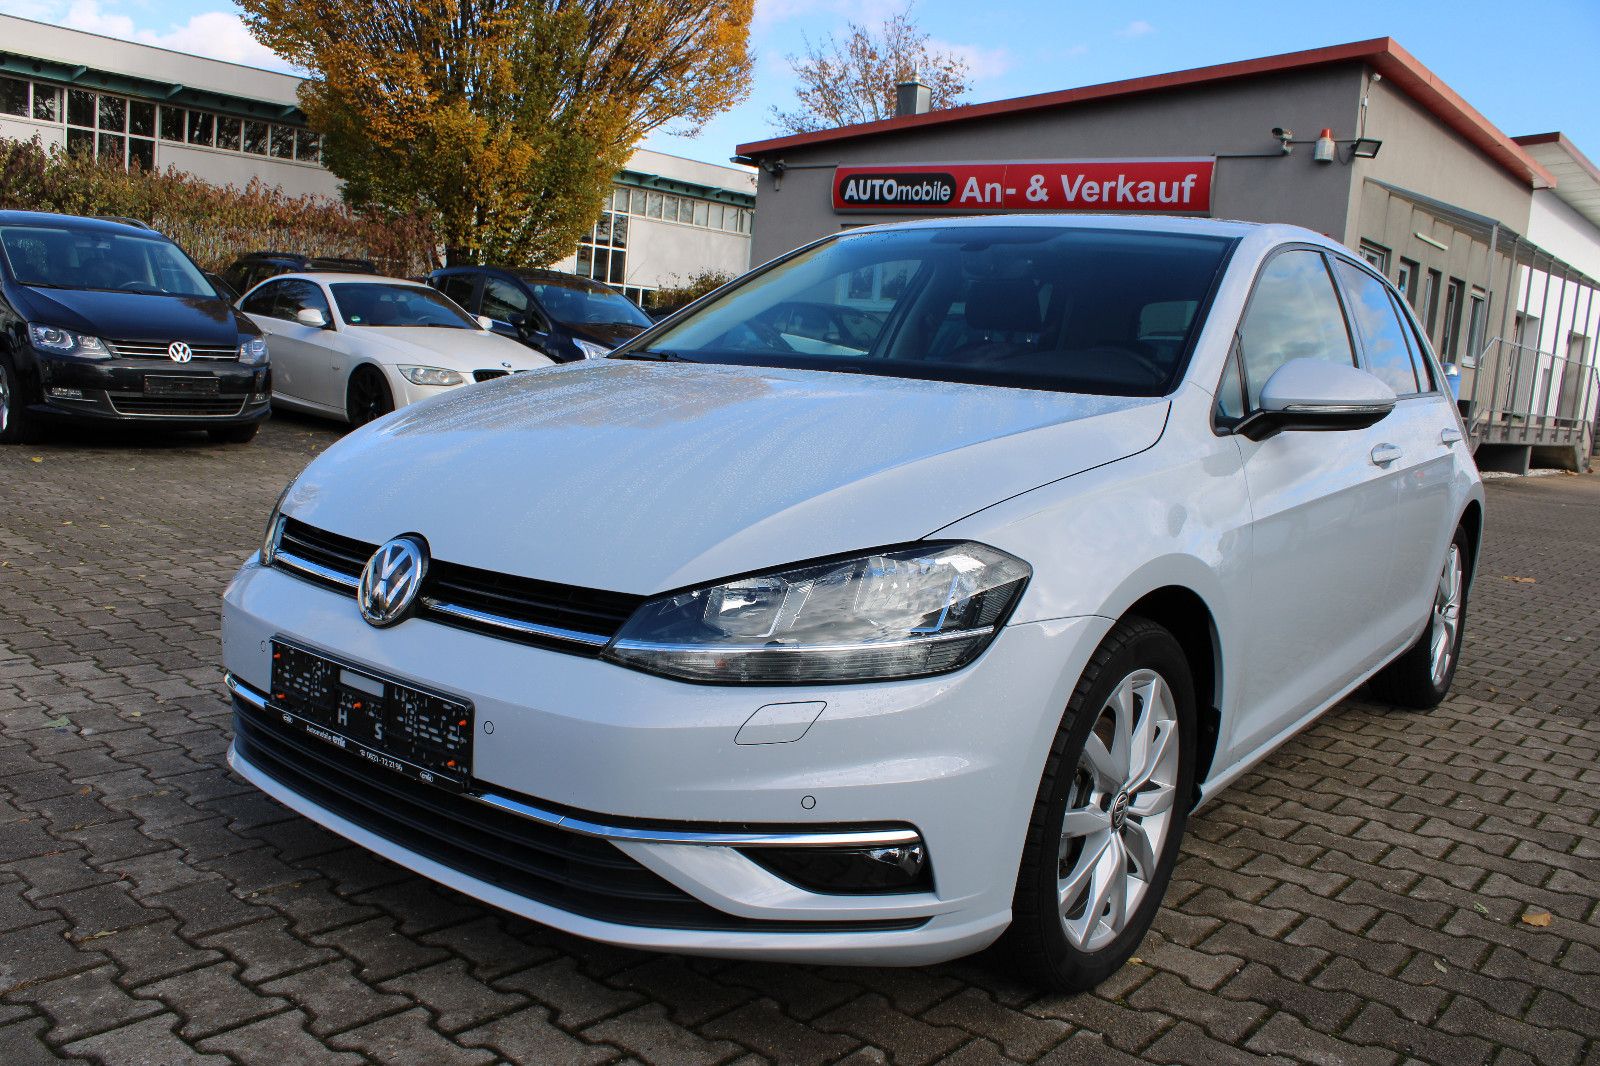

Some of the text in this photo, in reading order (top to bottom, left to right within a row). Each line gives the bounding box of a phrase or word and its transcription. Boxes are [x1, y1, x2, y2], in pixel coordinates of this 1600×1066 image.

[844, 173, 1198, 204] AUTOmobile An- & Verkauf
[168, 341, 192, 363] VW
[359, 538, 422, 624] VW
